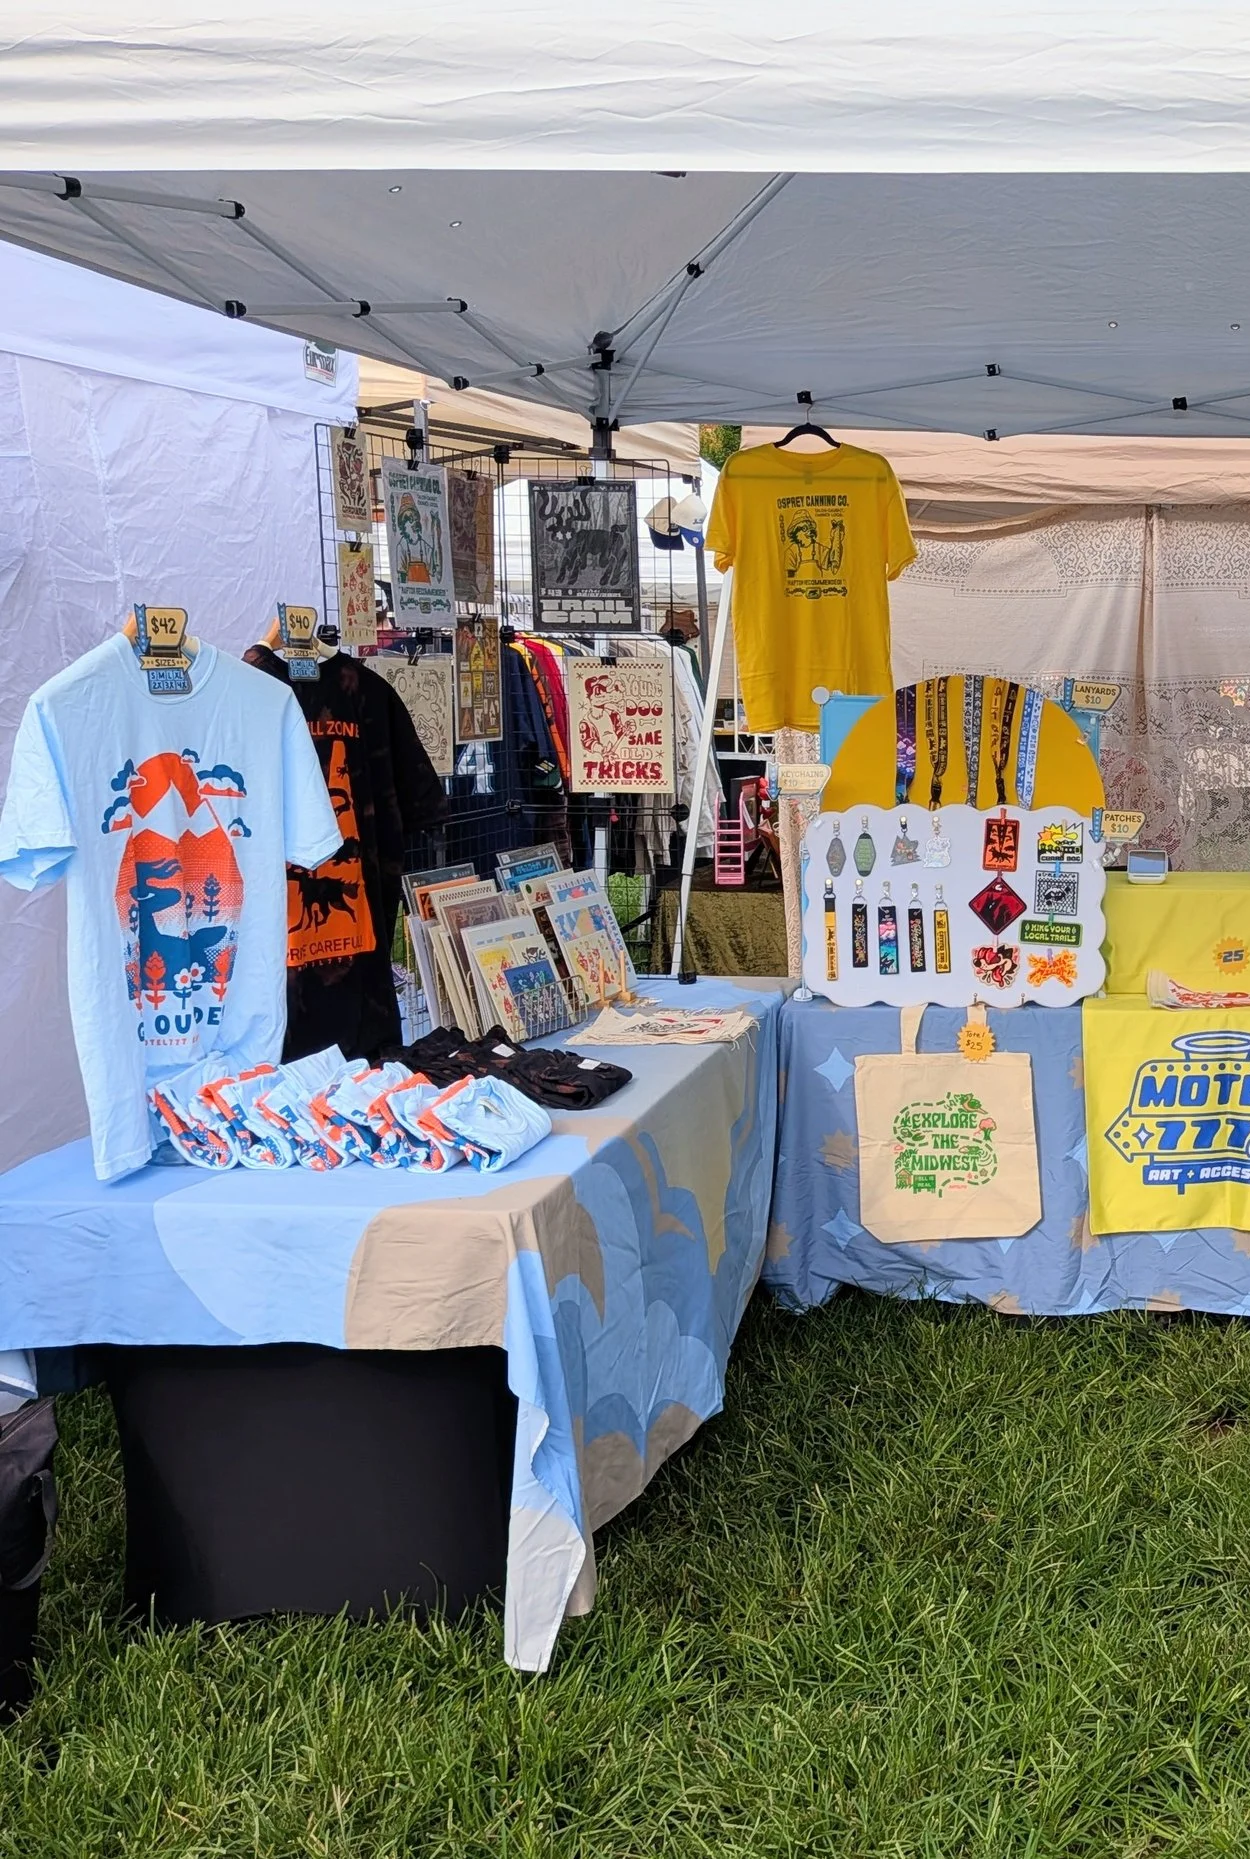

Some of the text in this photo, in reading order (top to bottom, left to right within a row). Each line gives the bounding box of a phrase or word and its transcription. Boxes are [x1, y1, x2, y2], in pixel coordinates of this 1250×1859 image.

[777, 494, 850, 509] OSPREY CANNING CO.
[540, 600, 633, 611] TRAIL
[290, 613, 310, 630] $40
[541, 611, 633, 624] CAM
[151, 616, 178, 635] $42
[293, 649, 309, 657] SIZES
[155, 658, 176, 667] SIZES
[151, 671, 183, 680] S M L XL
[152, 681, 187, 690] 2X 3X 4X
[1075, 684, 1117, 696] LANYARDS
[1084, 695, 1101, 705] $10
[625, 700, 663, 716] DOG
[326, 720, 360, 738] ZONE
[628, 730, 663, 745] SAME
[620, 747, 653, 761] OLD
[583, 761, 663, 779] TRICKS
[781, 770, 825, 778] KEYCHAINS
[784, 779, 798, 787] $10
[1104, 813, 1142, 823] PATCHES
[1110, 823, 1129, 834] $10
[1050, 924, 1071, 934] YOUR
[1024, 932, 1077, 943] LOCAL TRAILS
[1217, 949, 1245, 963] $25
[965, 1030, 985, 1038] Tote!
[966, 1039, 983, 1051] $25
[912, 1113, 977, 1129] EXPLORE
[931, 1134, 959, 1149] THE
[911, 1155, 980, 1172] MIDWEST
[1148, 1168, 1183, 1181] ART
[1186, 1169, 1195, 1178] +
